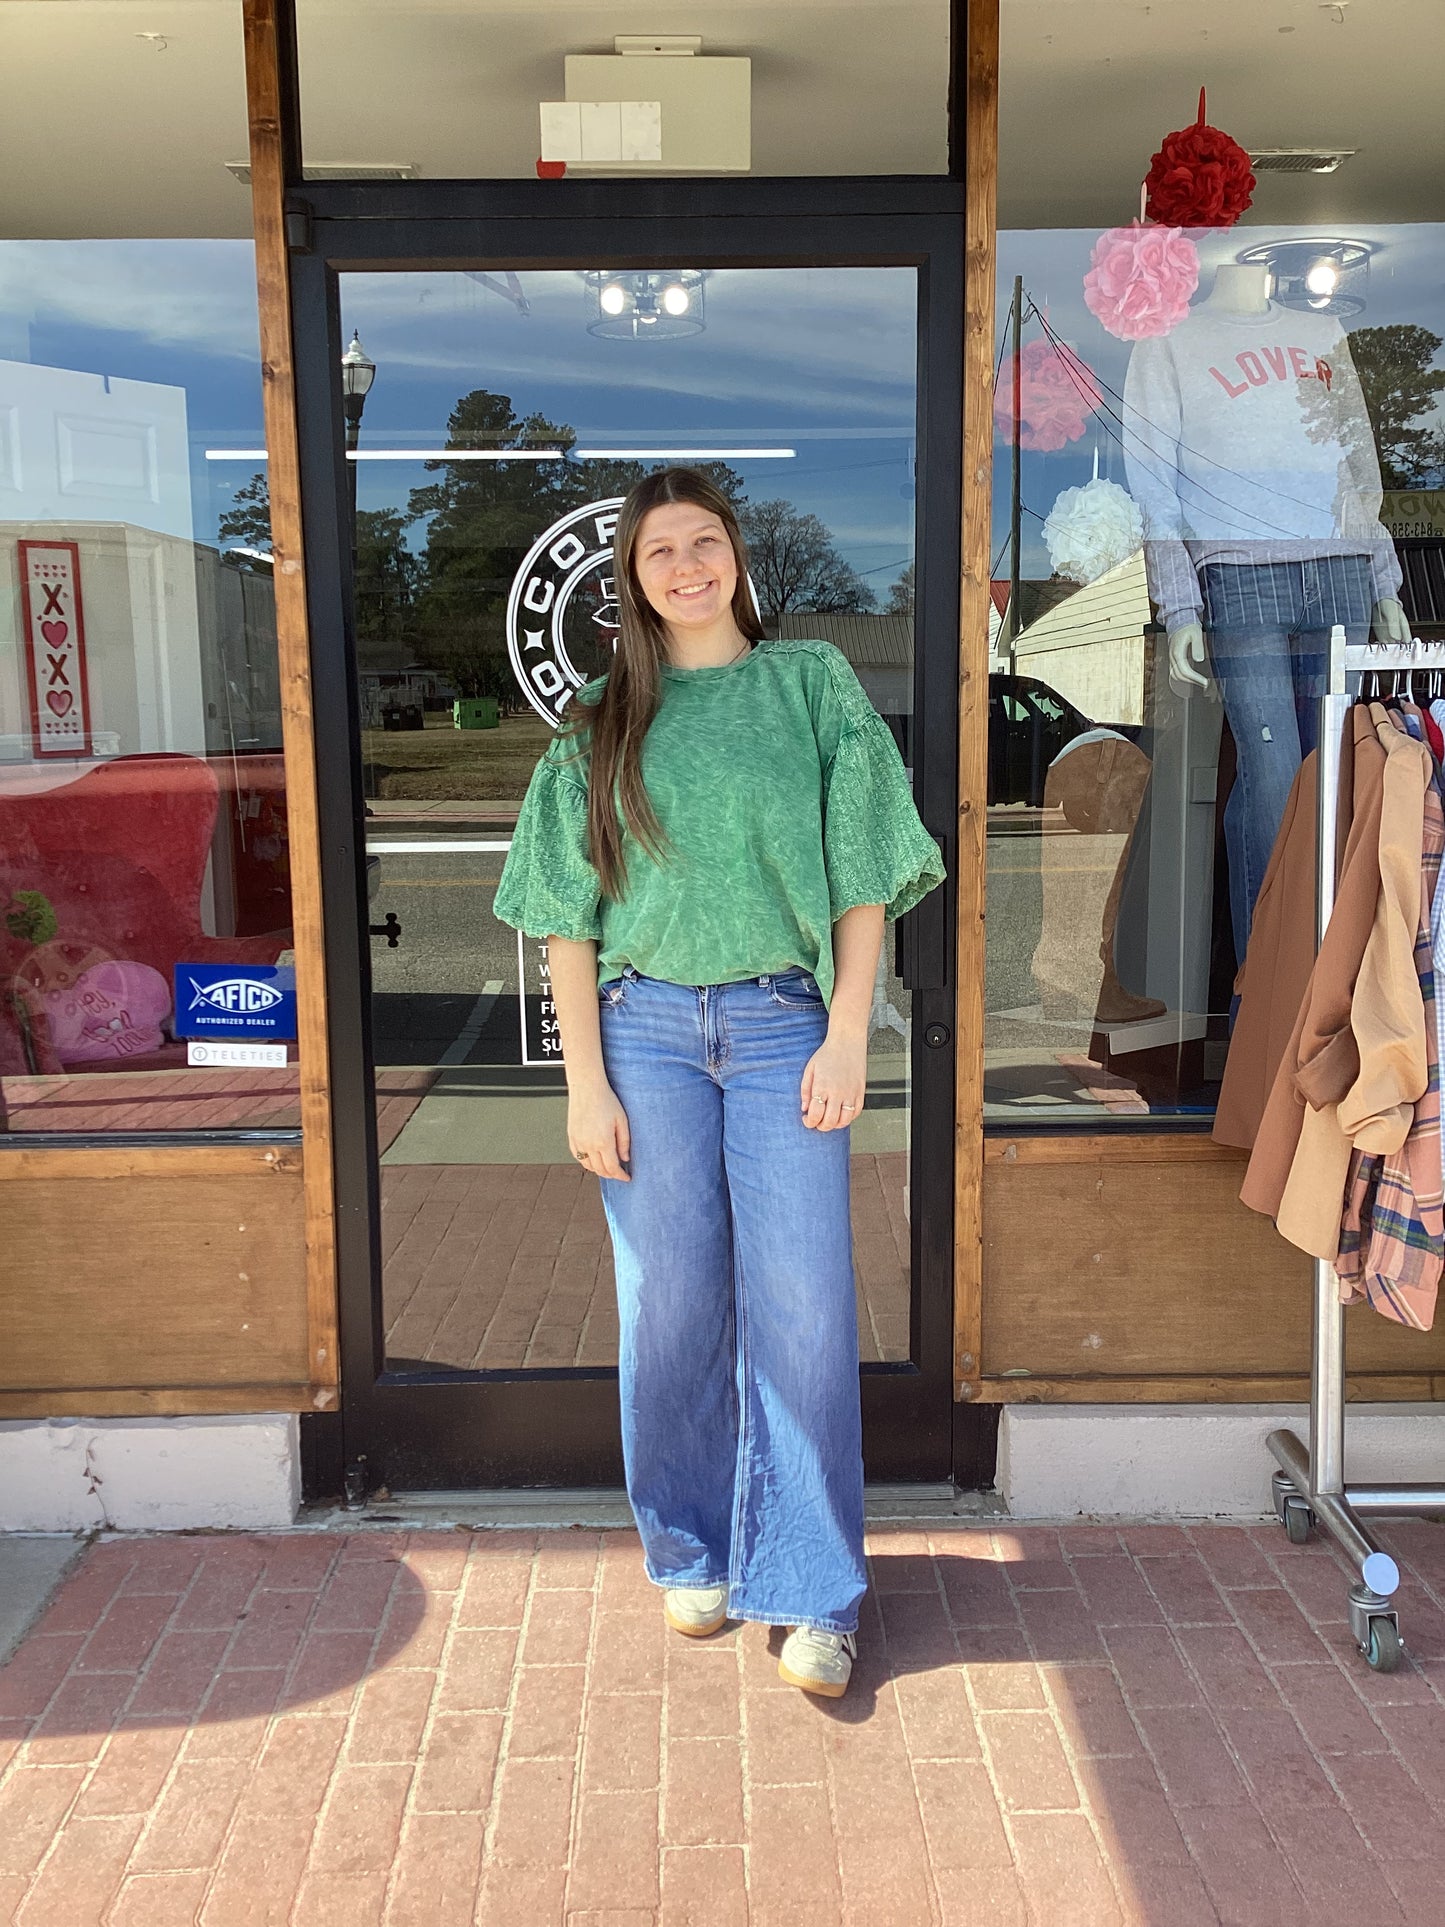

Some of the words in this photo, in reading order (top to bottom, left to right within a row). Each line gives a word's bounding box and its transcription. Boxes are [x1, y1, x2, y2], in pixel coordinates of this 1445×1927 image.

[1208, 346, 1333, 399] LOVER
[210, 982, 275, 1011] AFTCO
[195, 1017, 245, 1026] AUTHORIZED
[246, 1018, 276, 1027] DEALER
[211, 1050, 284, 1062] TELETIES
